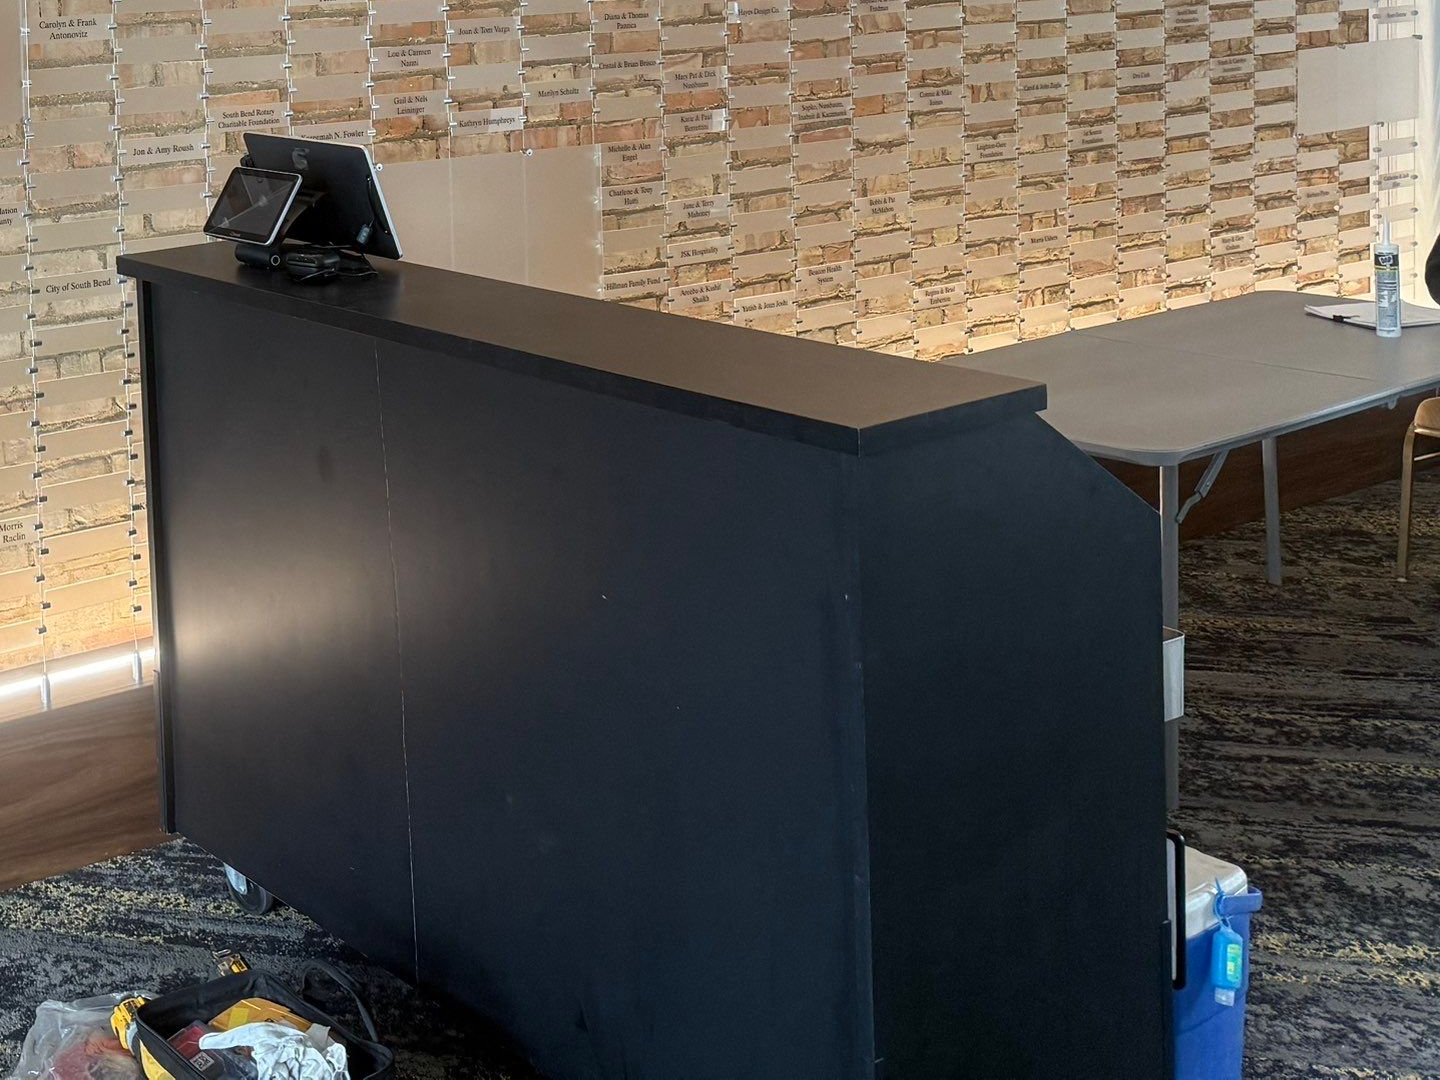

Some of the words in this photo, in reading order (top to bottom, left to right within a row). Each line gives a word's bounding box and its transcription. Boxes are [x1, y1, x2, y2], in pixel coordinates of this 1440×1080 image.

[39, 20, 67, 31] Carolyn
[68, 19, 75, 27] &
[77, 18, 97, 27] Frank
[133, 147, 145, 156] Jon
[155, 146, 171, 156] Amy
[173, 144, 194, 152] Roush
[45, 283, 60, 295] City
[62, 283, 70, 291] of
[71, 280, 90, 291] South
[91, 278, 111, 289] Bend
[0, 521, 23, 533] Morris
